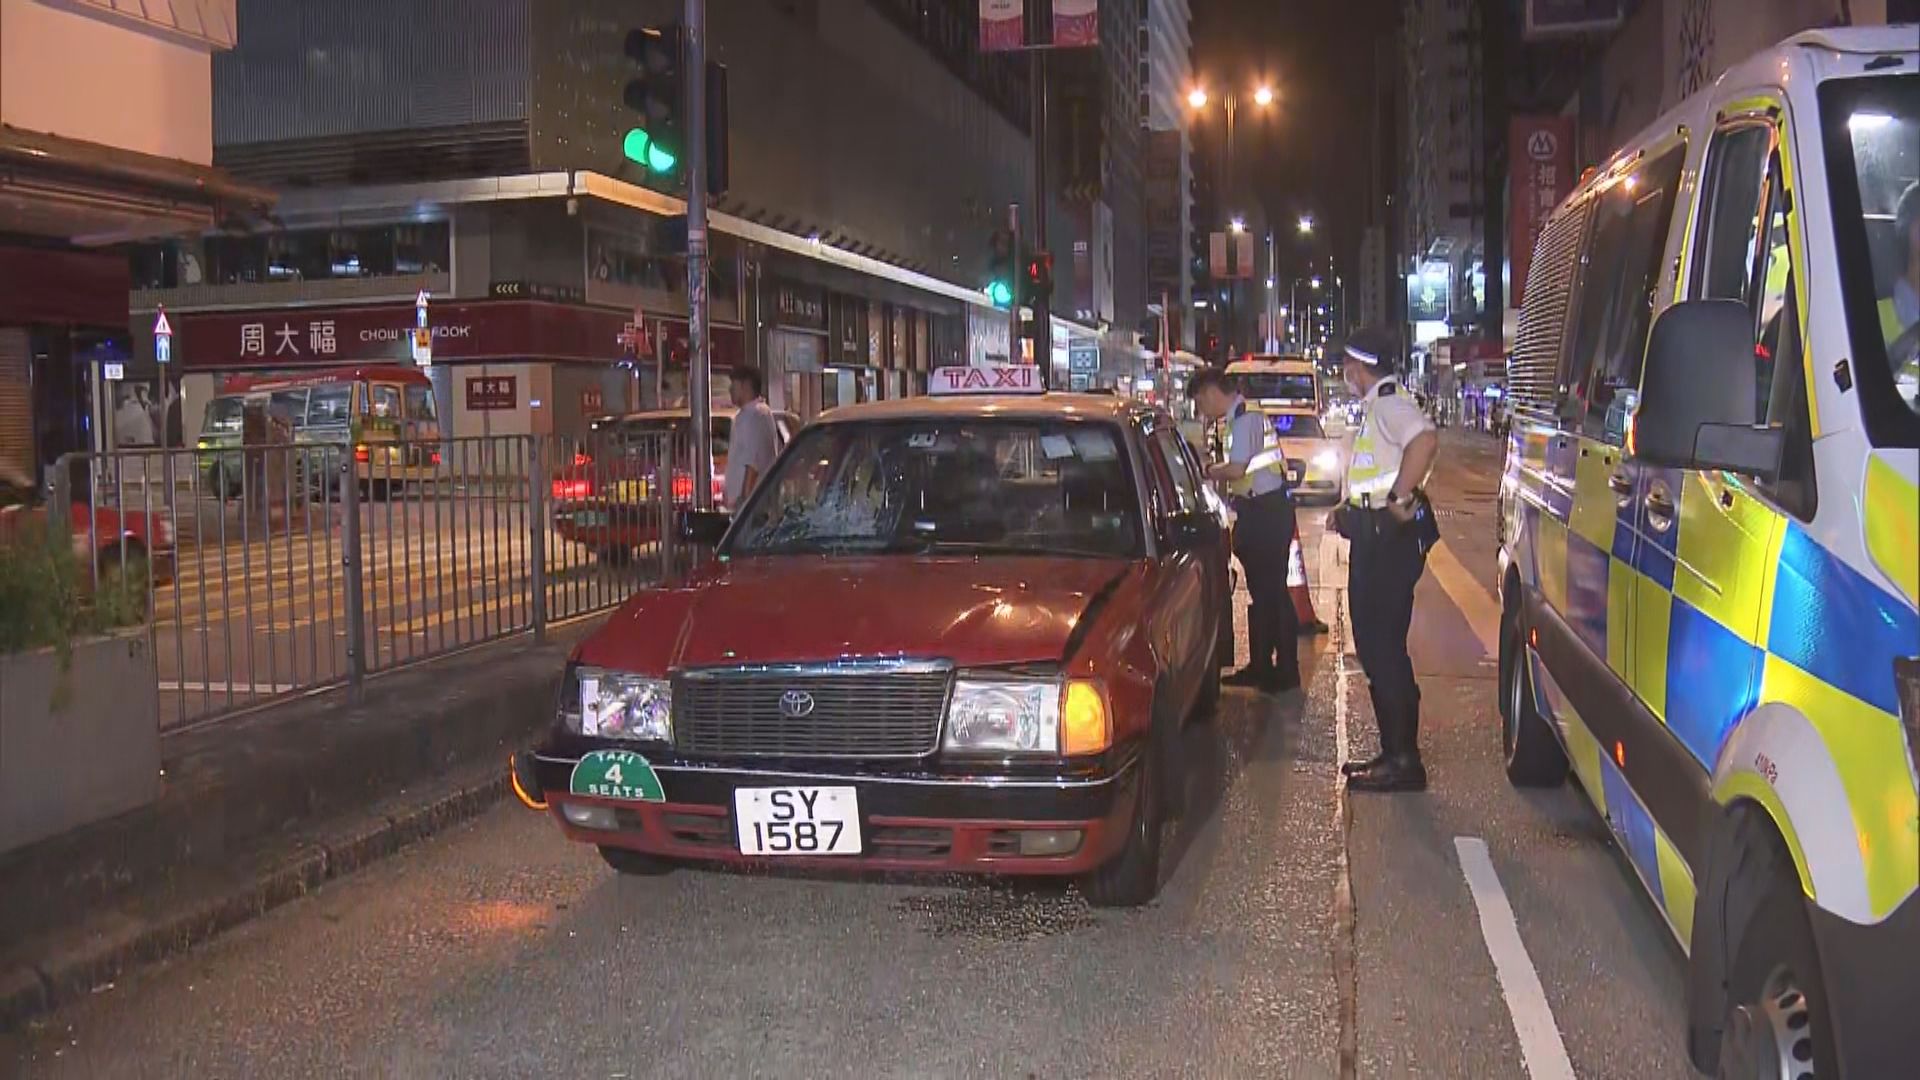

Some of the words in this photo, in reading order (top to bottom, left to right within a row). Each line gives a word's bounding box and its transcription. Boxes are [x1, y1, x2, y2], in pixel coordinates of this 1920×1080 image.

[241, 320, 337, 356] 周大福
[360, 329, 398, 341] CHOW
[943, 368, 1031, 388] TAXI
[604, 763, 623, 784] 4
[588, 783, 645, 797] SEATS
[771, 790, 818, 821] SY
[753, 820, 844, 851] 1587
